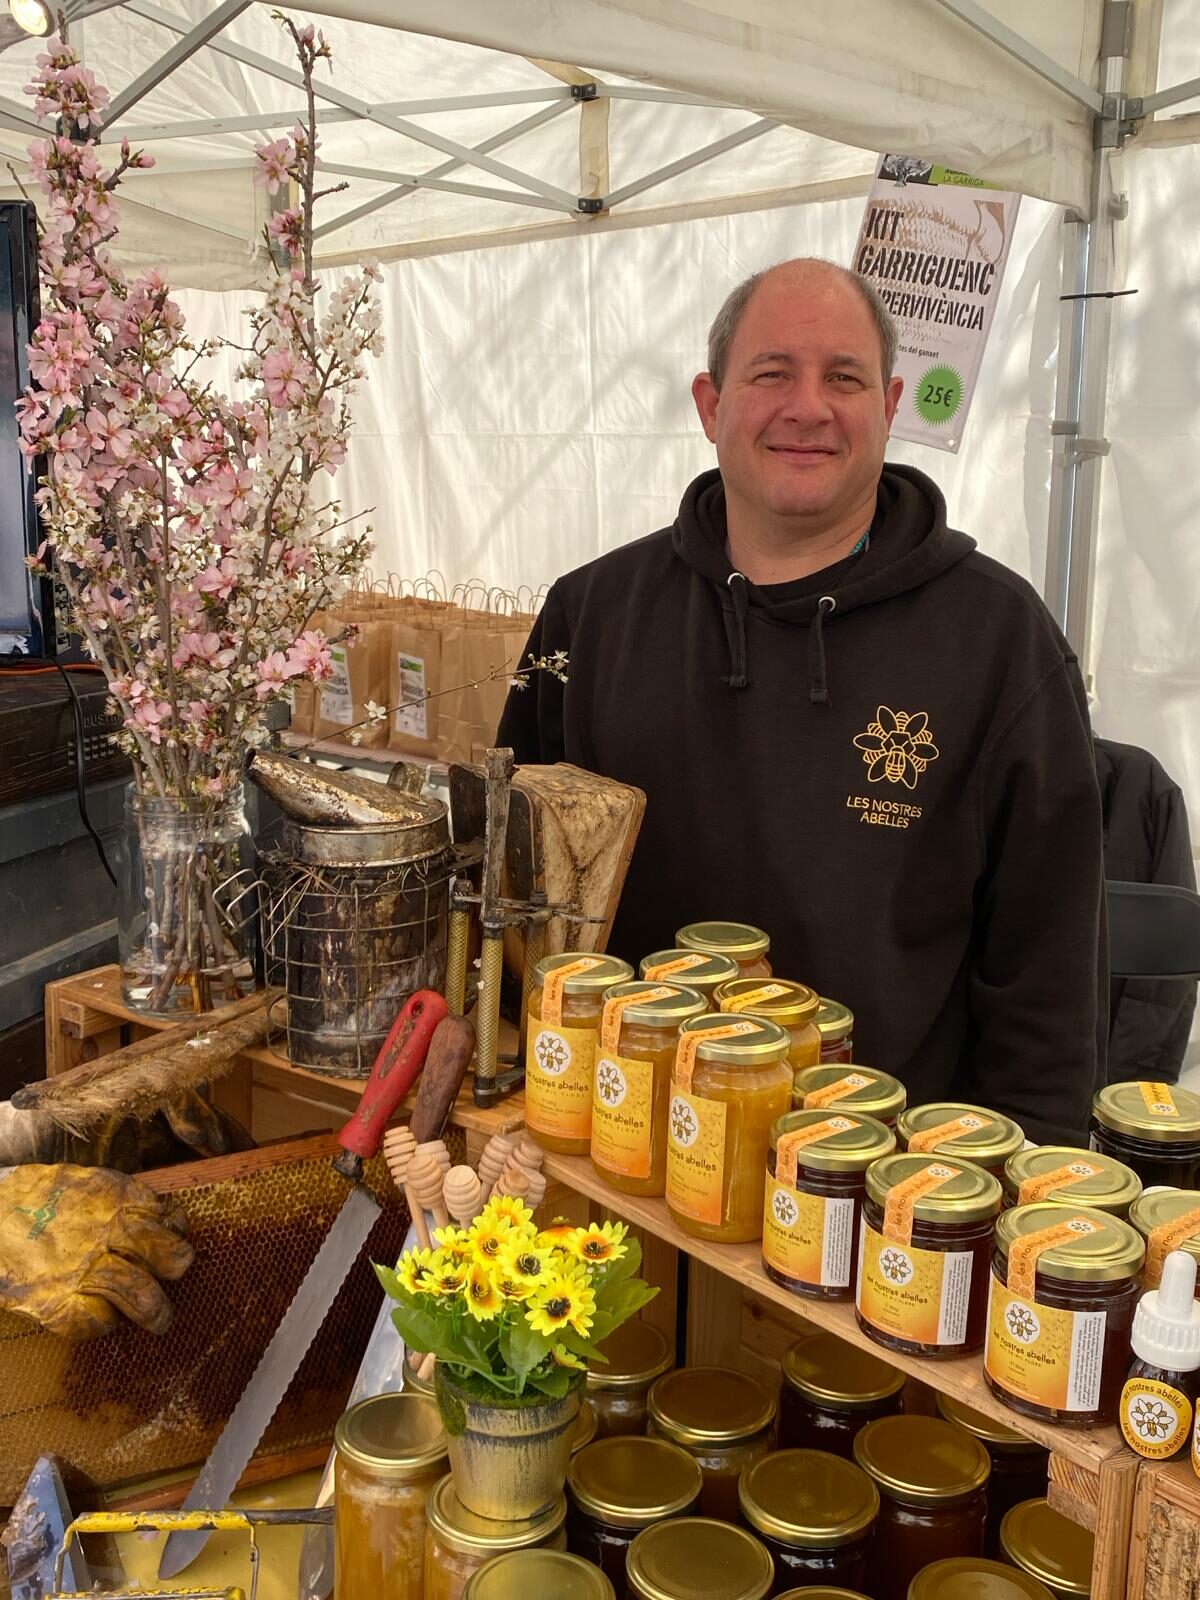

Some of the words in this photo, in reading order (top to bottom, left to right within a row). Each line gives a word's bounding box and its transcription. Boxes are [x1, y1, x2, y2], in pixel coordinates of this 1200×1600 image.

[866, 208, 905, 242] KIT
[858, 245, 995, 296] GARRIGUENC
[879, 288, 984, 331] PERVIVÈNCIA
[923, 384, 953, 408] 25€
[847, 796, 870, 808] LES
[872, 800, 922, 818] NOSTRES
[860, 812, 910, 828] ABELLES
[558, 1080, 588, 1092] abelles
[614, 1114, 644, 1128] abelles
[686, 1154, 716, 1171] abelles
[1016, 1262, 1026, 1276] les
[874, 1281, 898, 1296] nostres
[900, 1290, 928, 1304] abelles
[1000, 1336, 1024, 1355] nostres
[1026, 1349, 1056, 1365] abelles
[1129, 1383, 1154, 1392] nostres
[1156, 1388, 1183, 1408] abelles
[1130, 1436, 1162, 1454] nostres
[1164, 1427, 1186, 1453] abelles
